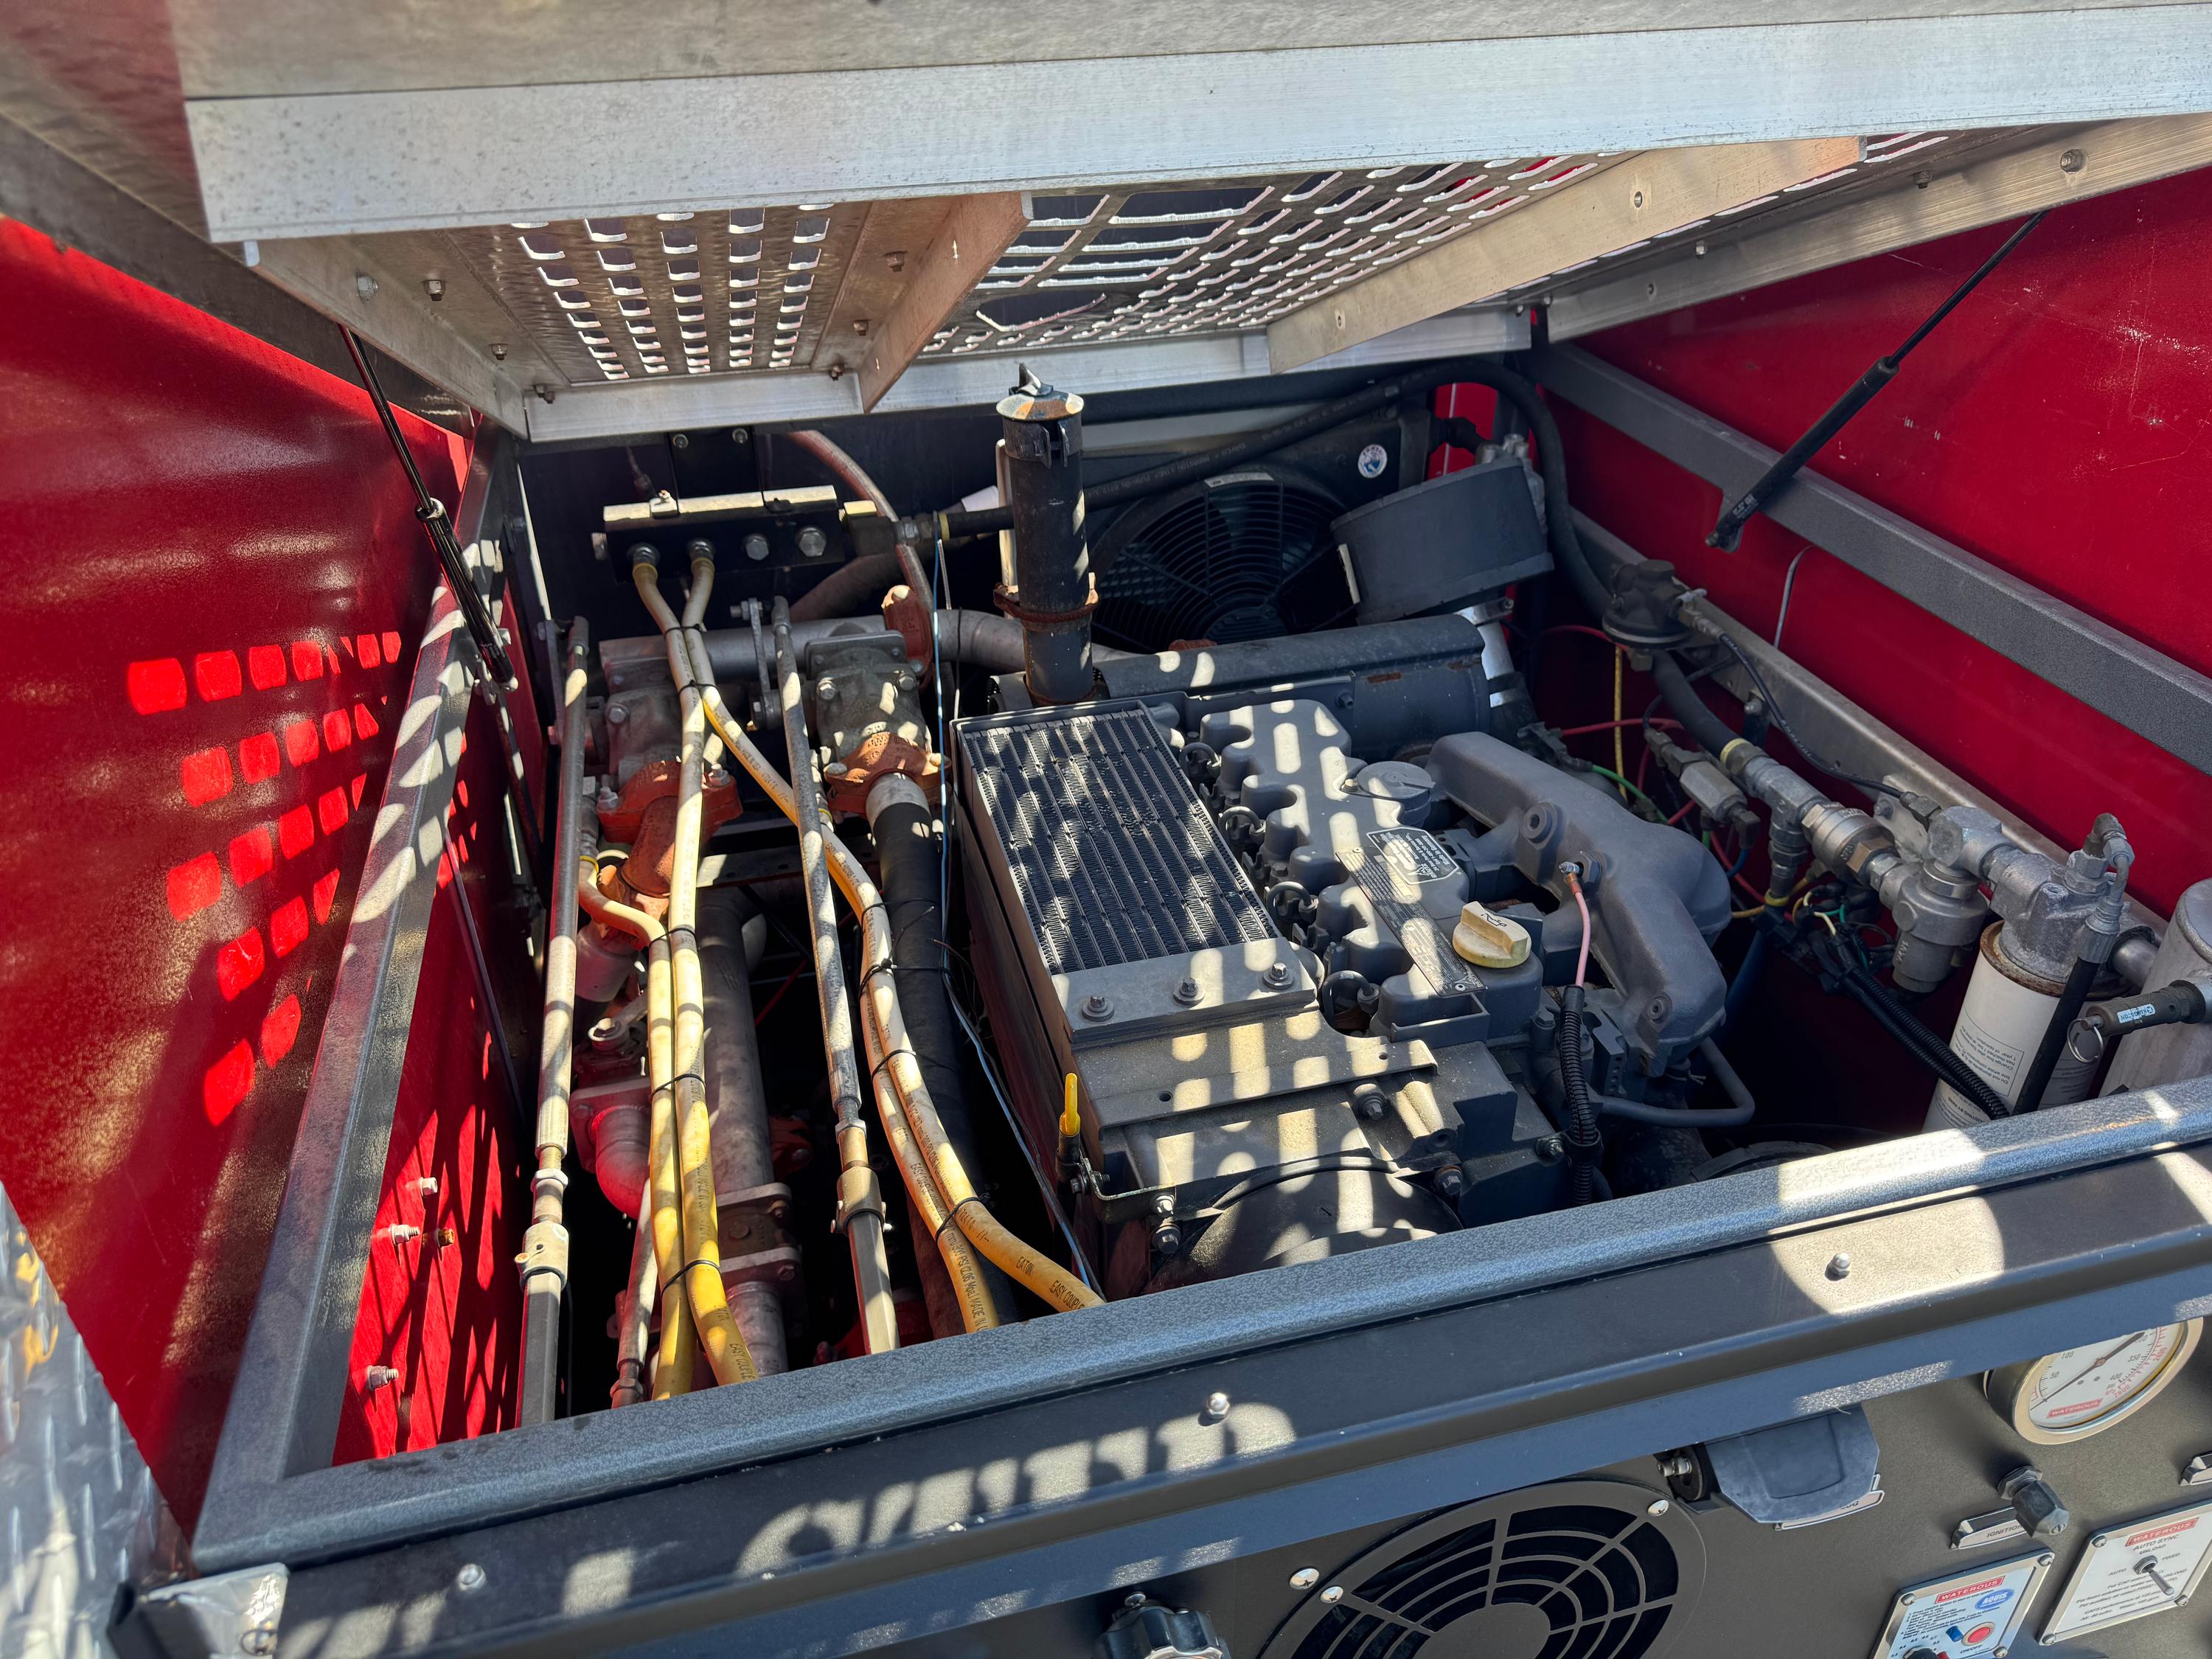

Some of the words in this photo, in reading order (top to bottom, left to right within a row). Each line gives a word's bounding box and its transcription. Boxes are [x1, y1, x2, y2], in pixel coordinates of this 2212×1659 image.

[1420, 833, 1437, 852] Germany
[1438, 853, 1450, 866] Made
[1986, 1066, 2000, 1075] whilst
[1994, 1059, 2014, 1071] Change
[958, 1255, 970, 1267] PSI
[1015, 1256, 1036, 1279] EATON
[960, 1266, 975, 1283] (2.06
[1049, 1280, 1067, 1300] EASY
[1062, 1291, 1085, 1310] COUPLE
[969, 1298, 986, 1319] MADE
[974, 1317, 989, 1327] IN
[729, 1343, 744, 1360] EASY
[2062, 1350, 2074, 1358] 100
[2127, 1353, 2141, 1363] 350
[736, 1357, 757, 1380] COUPLE
[2049, 1371, 2059, 1379] 50
[2110, 1372, 2123, 1381] 400
[2112, 1385, 2131, 1398] 2800
[2051, 1401, 2100, 1415] WATEROUS
[2133, 1522, 2191, 1543] WATEROUS
[2132, 1541, 2154, 1551] AUTO
[2157, 1534, 2180, 1543] SYNC
[2139, 1544, 2166, 1555] UNLOAD
[2162, 1553, 2180, 1561] FIXED
[2108, 1568, 2127, 1576] AUTO
[1941, 1580, 1999, 1600] WATEROUS
[1982, 1591, 2008, 1606] AQUIS
[2083, 1606, 2101, 1615] CAFS
[1960, 1645, 1983, 1654] ON/OFF
